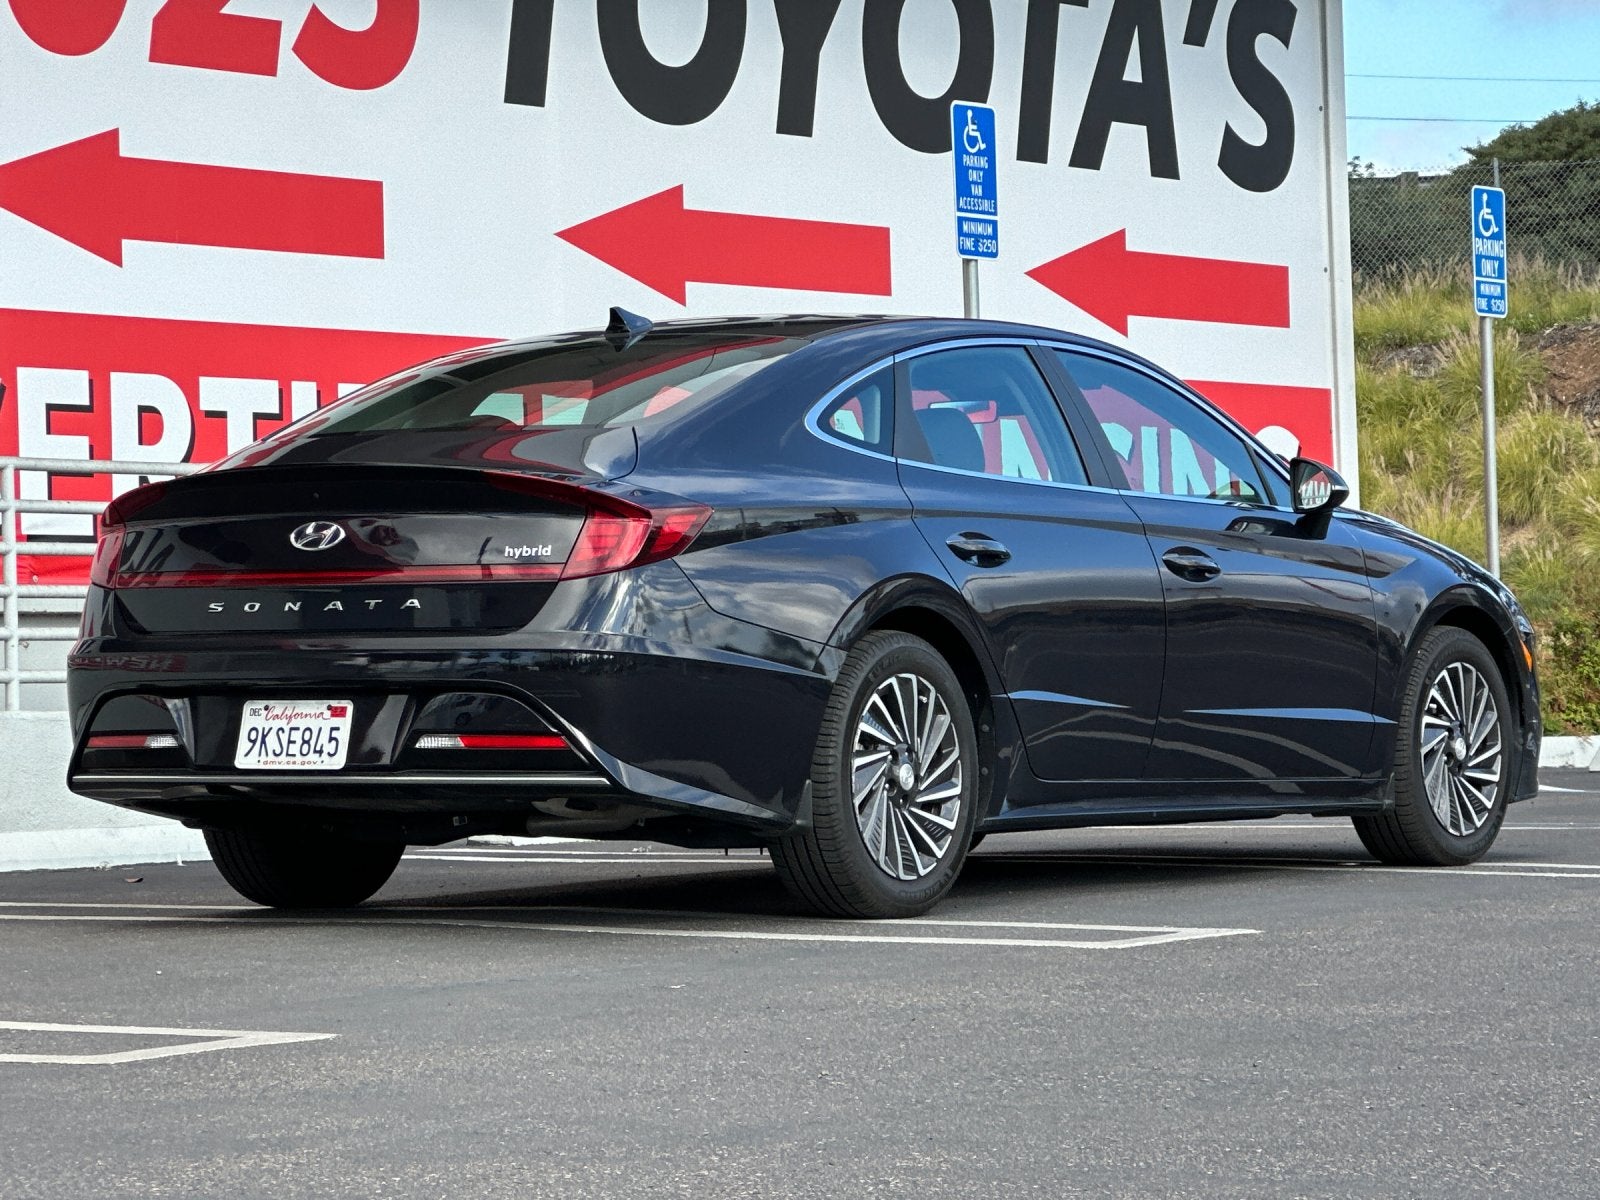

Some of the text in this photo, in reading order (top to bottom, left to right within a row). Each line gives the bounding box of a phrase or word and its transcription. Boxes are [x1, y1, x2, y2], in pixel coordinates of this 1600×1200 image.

[962, 154, 989, 169] PARKING
[968, 169, 983, 182] ONLY
[971, 183, 983, 197] VAN
[959, 197, 995, 213] ACCESSIBLE
[962, 220, 993, 236] MINIMUM
[959, 236, 997, 253] FINE $250
[1475, 237, 1504, 258] PARKING
[1481, 258, 1499, 277] ONLY
[1477, 297, 1505, 313] FINE $250
[504, 545, 552, 560] hybrid
[208, 598, 422, 613] SONATA
[249, 707, 262, 717] DEC
[265, 705, 331, 726] California
[244, 726, 340, 758] 9KSE845
